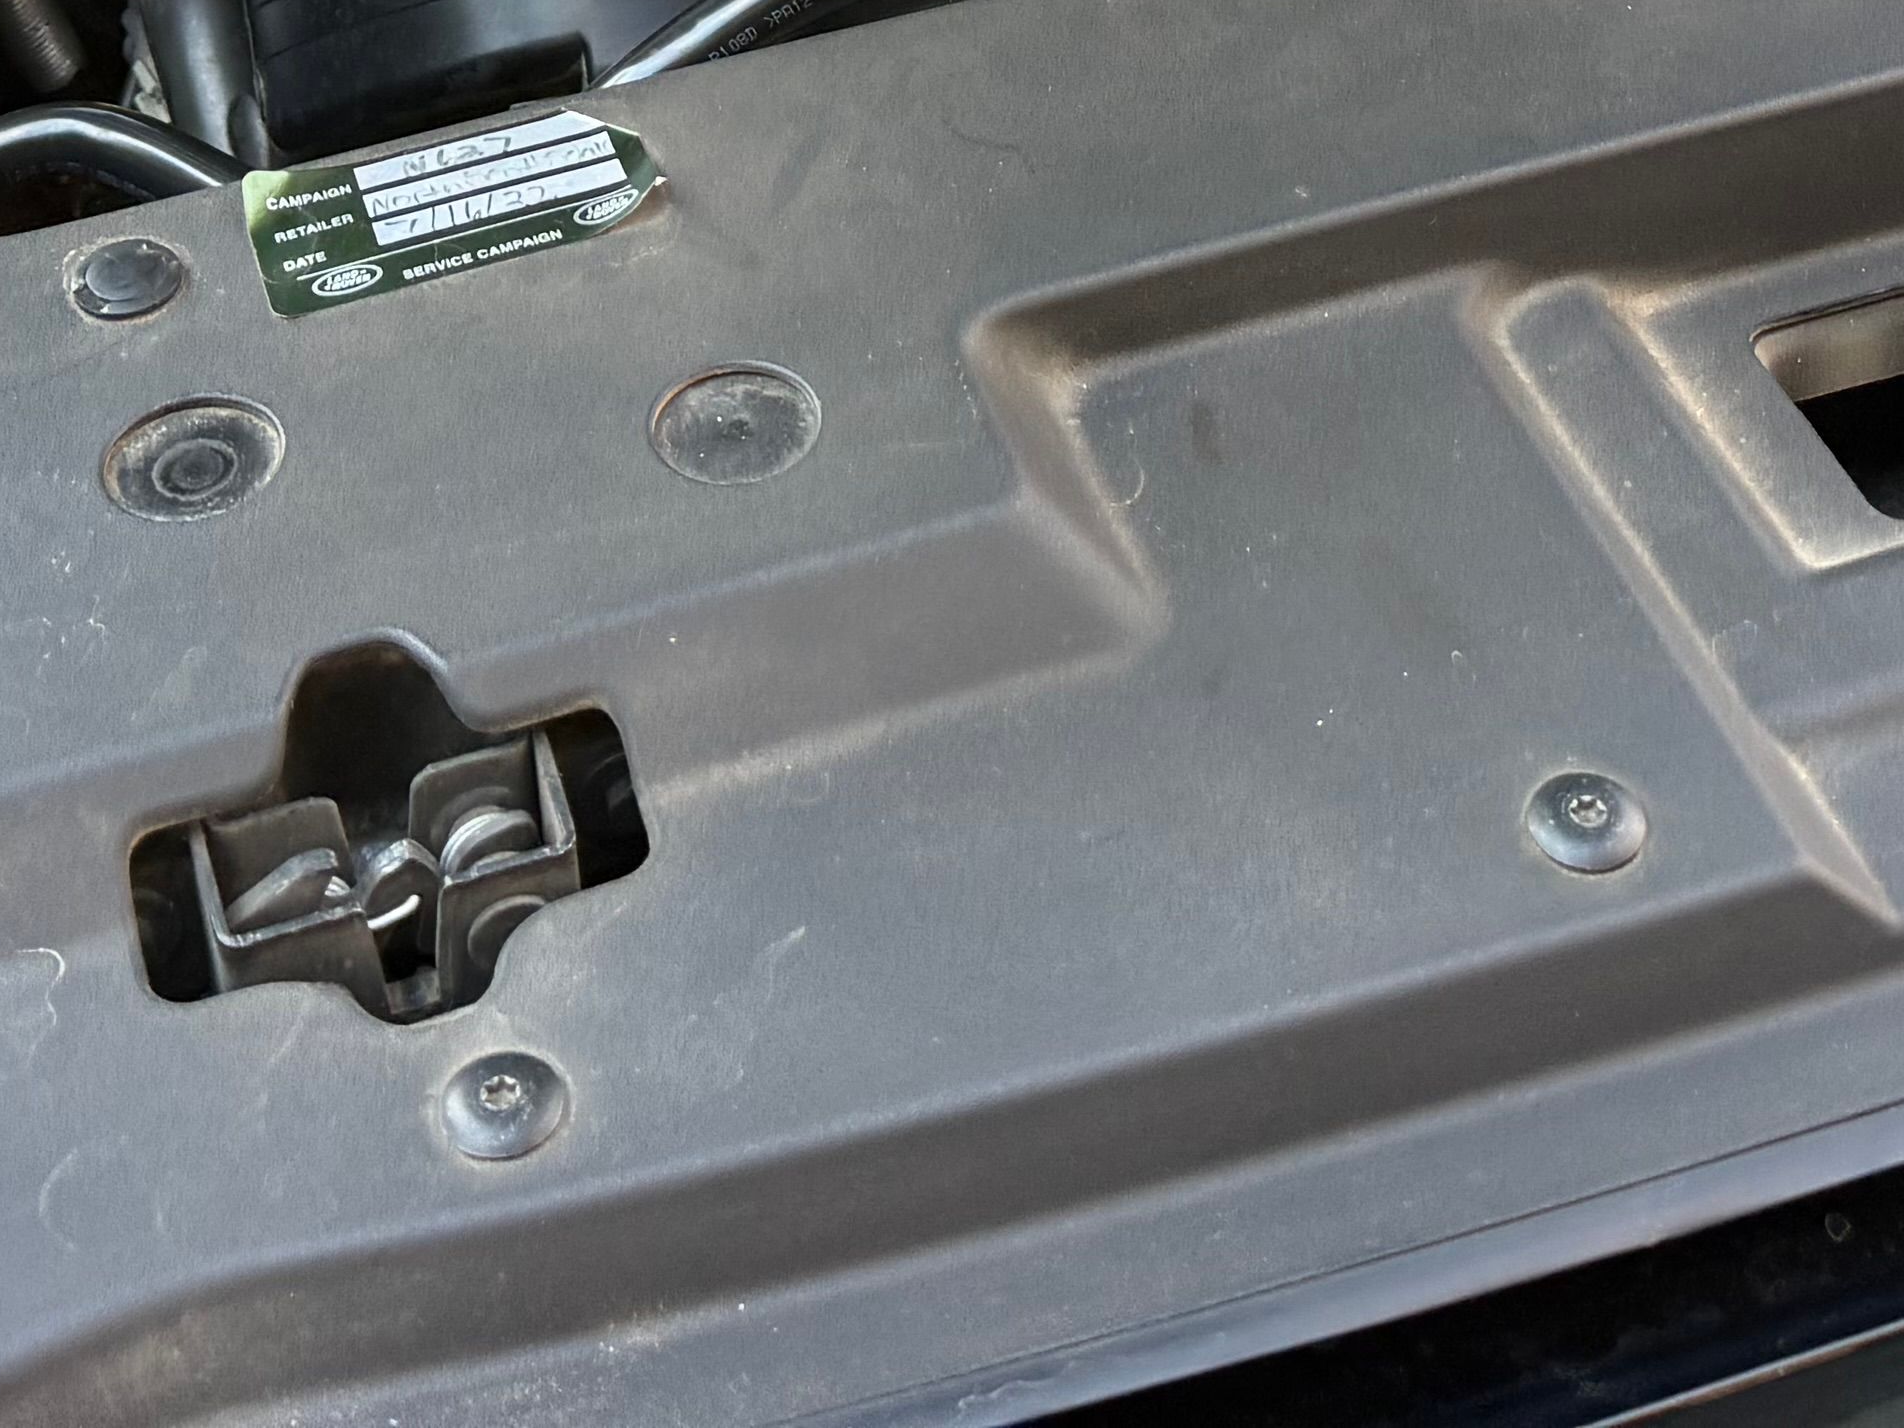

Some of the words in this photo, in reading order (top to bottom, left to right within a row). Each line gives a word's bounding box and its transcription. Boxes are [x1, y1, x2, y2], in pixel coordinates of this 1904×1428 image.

[266, 183, 353, 211] CAMPAIGN
[274, 213, 355, 244] RETAILER
[283, 250, 328, 273] DATE
[402, 252, 474, 280] SERVICE
[477, 229, 564, 260] CAMPAIGN
